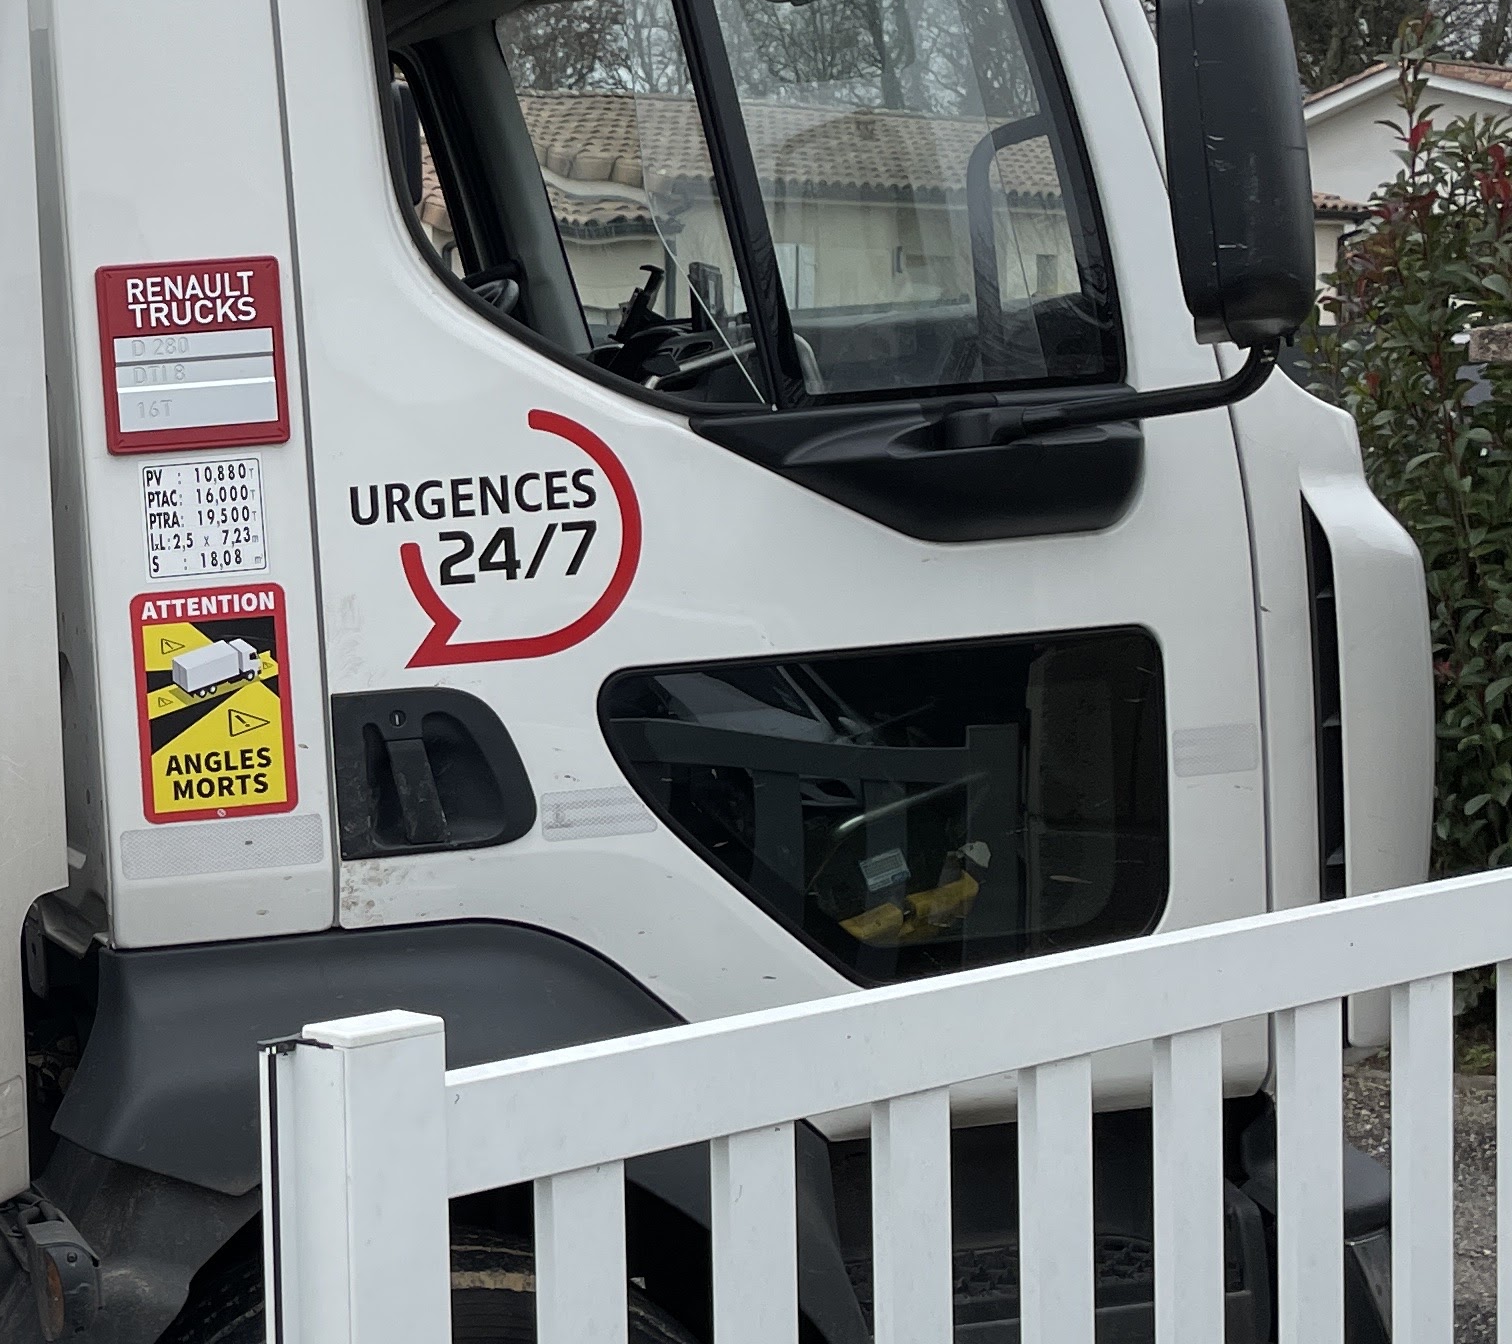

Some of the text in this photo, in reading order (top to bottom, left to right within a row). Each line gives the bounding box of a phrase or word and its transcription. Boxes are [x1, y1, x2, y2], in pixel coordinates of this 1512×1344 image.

[126, 271, 254, 303] RENAULT
[128, 297, 257, 328] TRUCKS
[131, 336, 189, 356] D 280
[174, 364, 186, 381] 8
[138, 399, 173, 418] 16T
[146, 469, 162, 487] PV
[349, 468, 597, 525] URGENCES
[152, 555, 160, 572] S
[438, 520, 597, 586] 24/7
[141, 591, 275, 620] ATTENTION
[166, 747, 272, 776] ANGLES
[173, 773, 269, 801] MORTS
